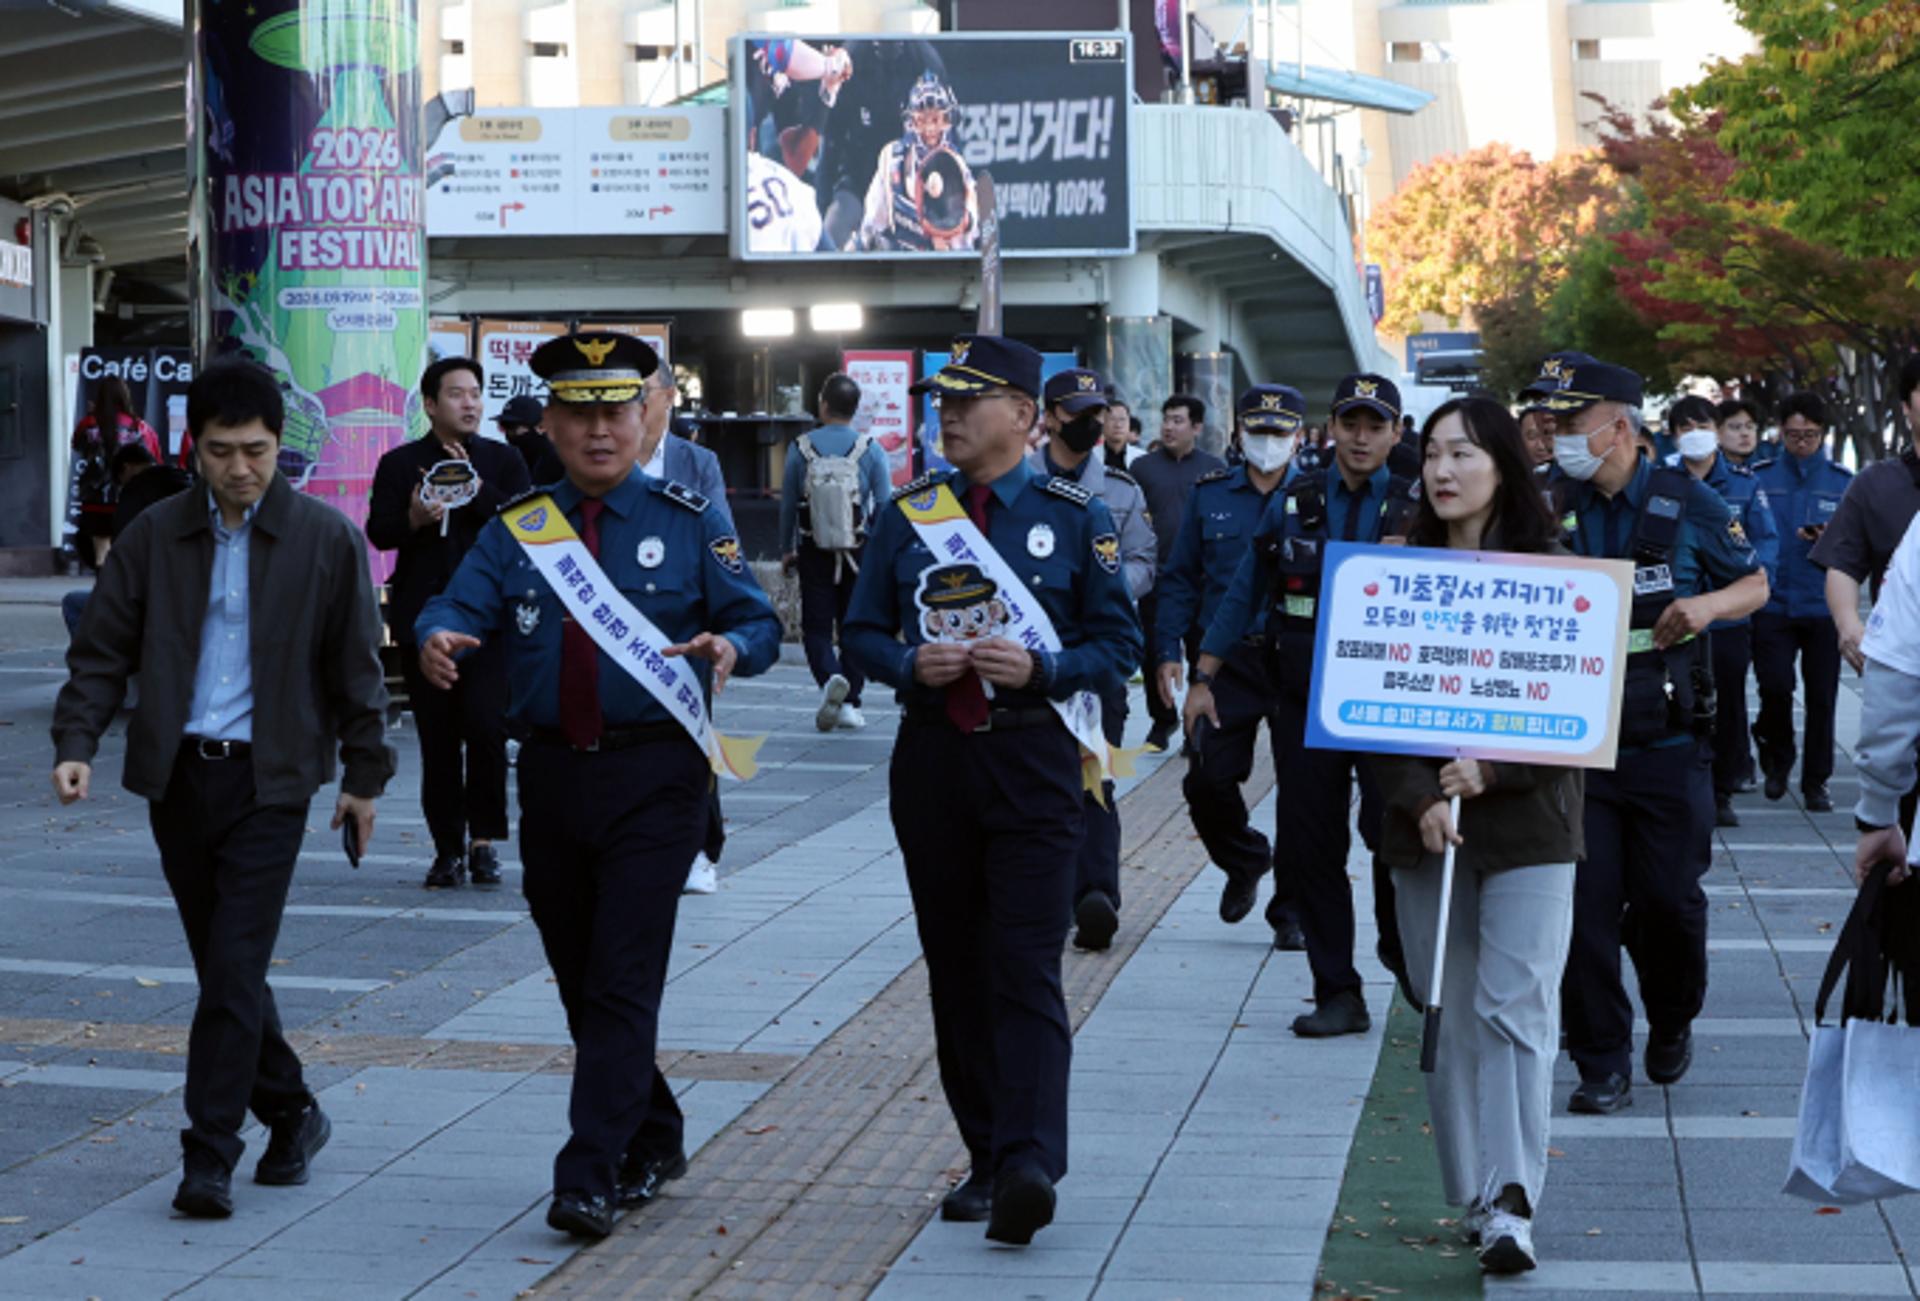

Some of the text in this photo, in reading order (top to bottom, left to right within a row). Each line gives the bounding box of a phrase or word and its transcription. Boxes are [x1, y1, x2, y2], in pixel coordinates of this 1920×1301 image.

[957, 97, 1114, 165] 정라거다!
[311, 129, 400, 169] 2026
[223, 174, 302, 231] ASIA
[307, 177, 374, 222] TOP
[1055, 177, 1106, 216] 100%
[281, 230, 419, 267] FESTIVAL
[82, 354, 148, 382] Café
[489, 340, 545, 366] 떡볶
[1387, 574, 1564, 607] 기초질서 지키기
[1363, 606, 1580, 642] 모두의 안전을 위한 첫걸음
[1388, 643, 1411, 663] NO
[1417, 645, 1469, 667] 호객행위
[1471, 648, 1494, 668] NO
[1580, 656, 1605, 676] NO
[1383, 671, 1551, 701] 음주소란 NO 노상방뇨 NO
[1346, 703, 1580, 738] 서울송파경찰서가 함께합니다
